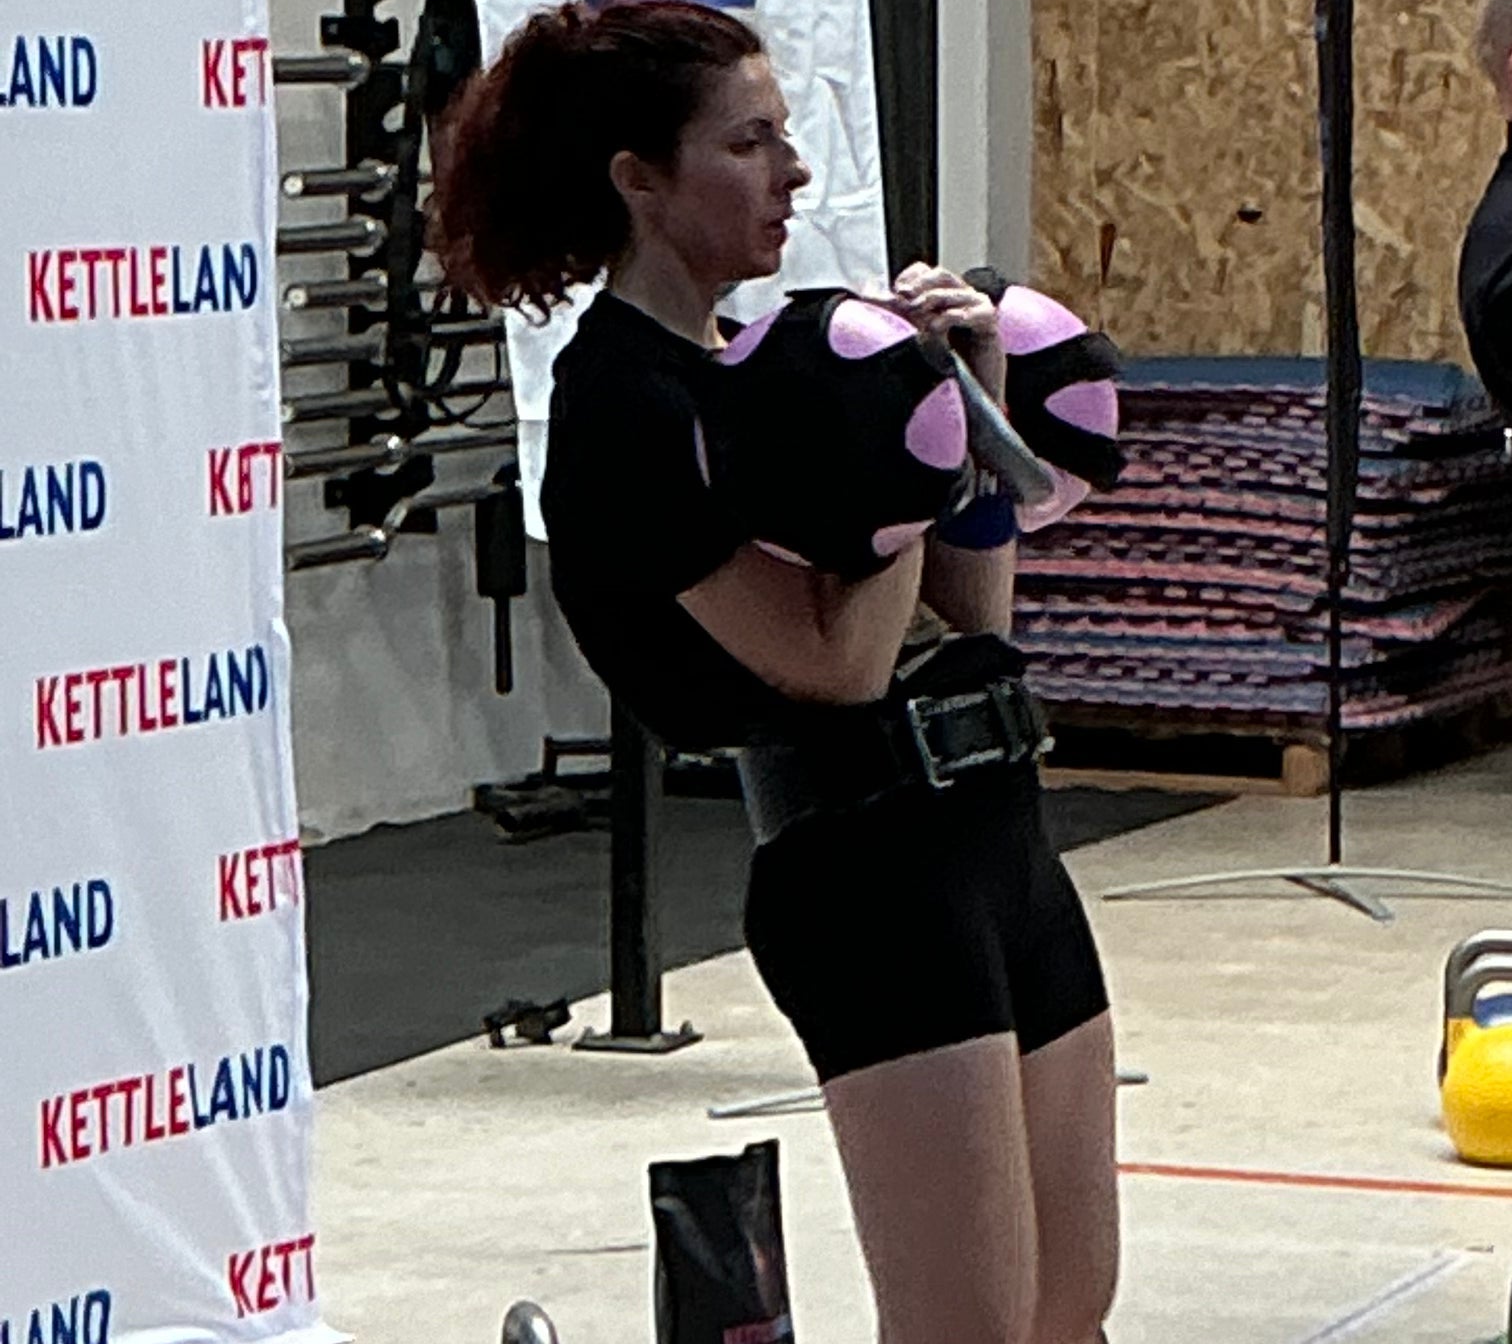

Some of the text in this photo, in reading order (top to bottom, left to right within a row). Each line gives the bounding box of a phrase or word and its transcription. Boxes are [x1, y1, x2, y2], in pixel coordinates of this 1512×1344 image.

[203, 38, 268, 108] KET
[209, 441, 282, 516] KET
[219, 839, 300, 922] KETT
[0, 880, 113, 969] LAND
[40, 1044, 290, 1169] KETTLELAND
[228, 1233, 315, 1318] KETT
